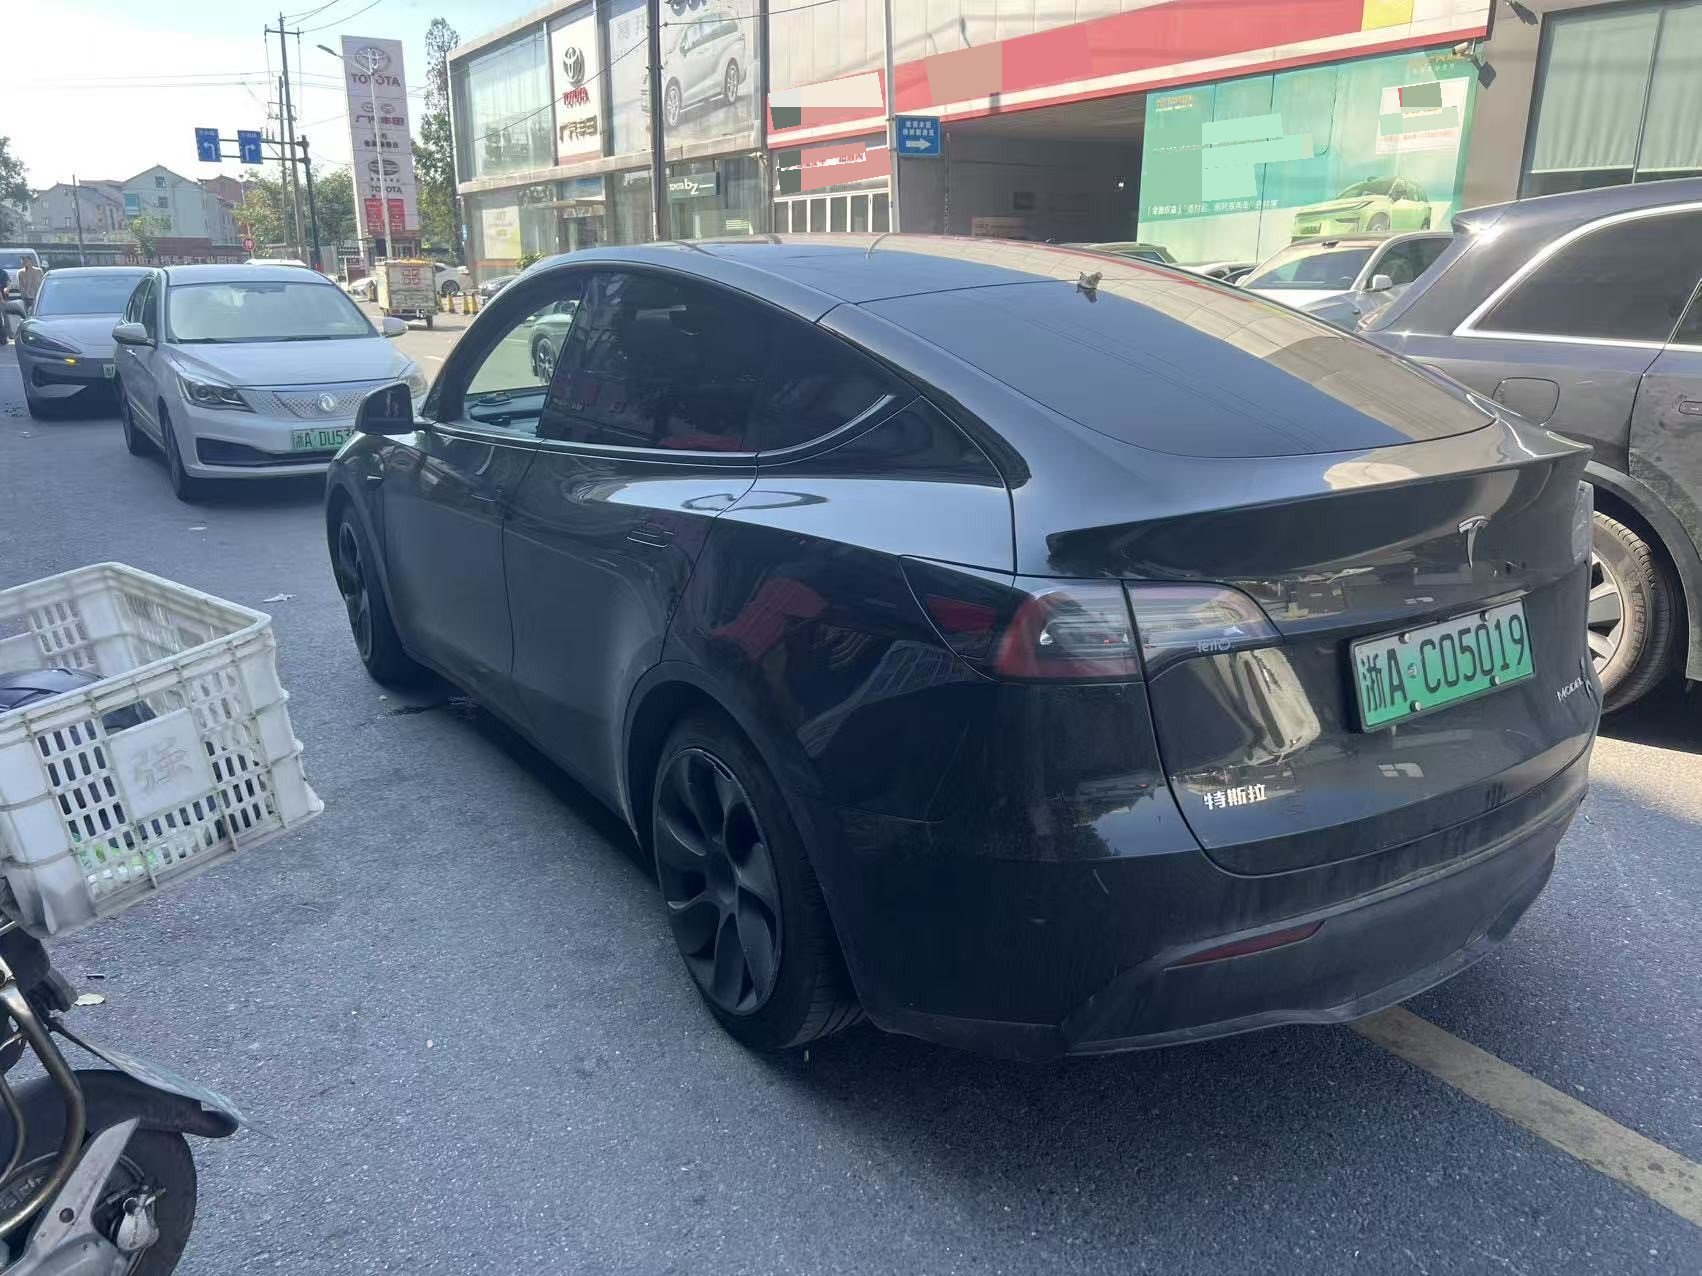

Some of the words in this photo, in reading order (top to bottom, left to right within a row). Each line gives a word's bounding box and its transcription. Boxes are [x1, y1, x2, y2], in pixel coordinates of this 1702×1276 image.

[370, 184, 402, 194] TOOTA
[1419, 613, 1525, 694] C05019
[1556, 677, 1584, 703] MODEL
[1203, 783, 1267, 811] 特斯拉
